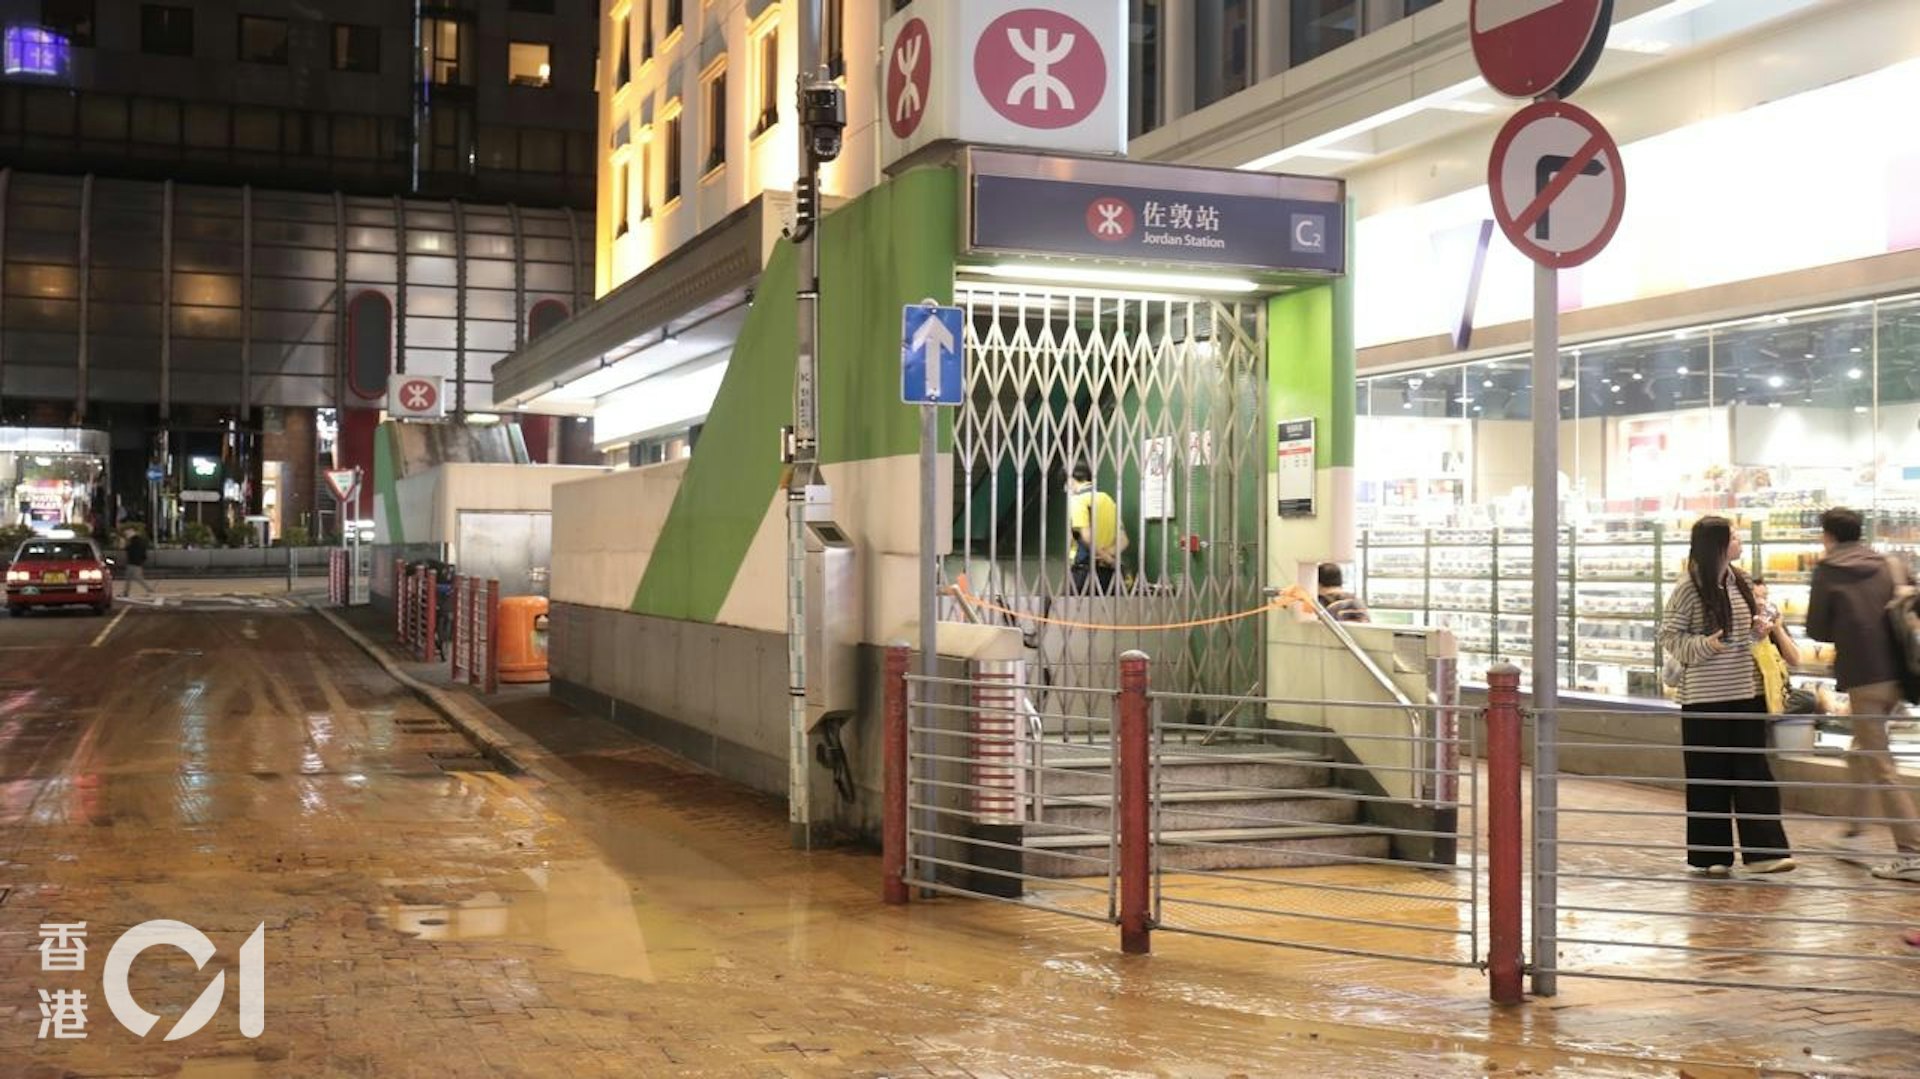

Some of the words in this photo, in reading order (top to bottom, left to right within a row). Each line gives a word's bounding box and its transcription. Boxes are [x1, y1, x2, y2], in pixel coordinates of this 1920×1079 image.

[1142, 201, 1220, 231] 佐敦站
[1142, 231, 1183, 246] Jordan
[1184, 234, 1225, 249] Station
[1295, 220, 1321, 247] C2
